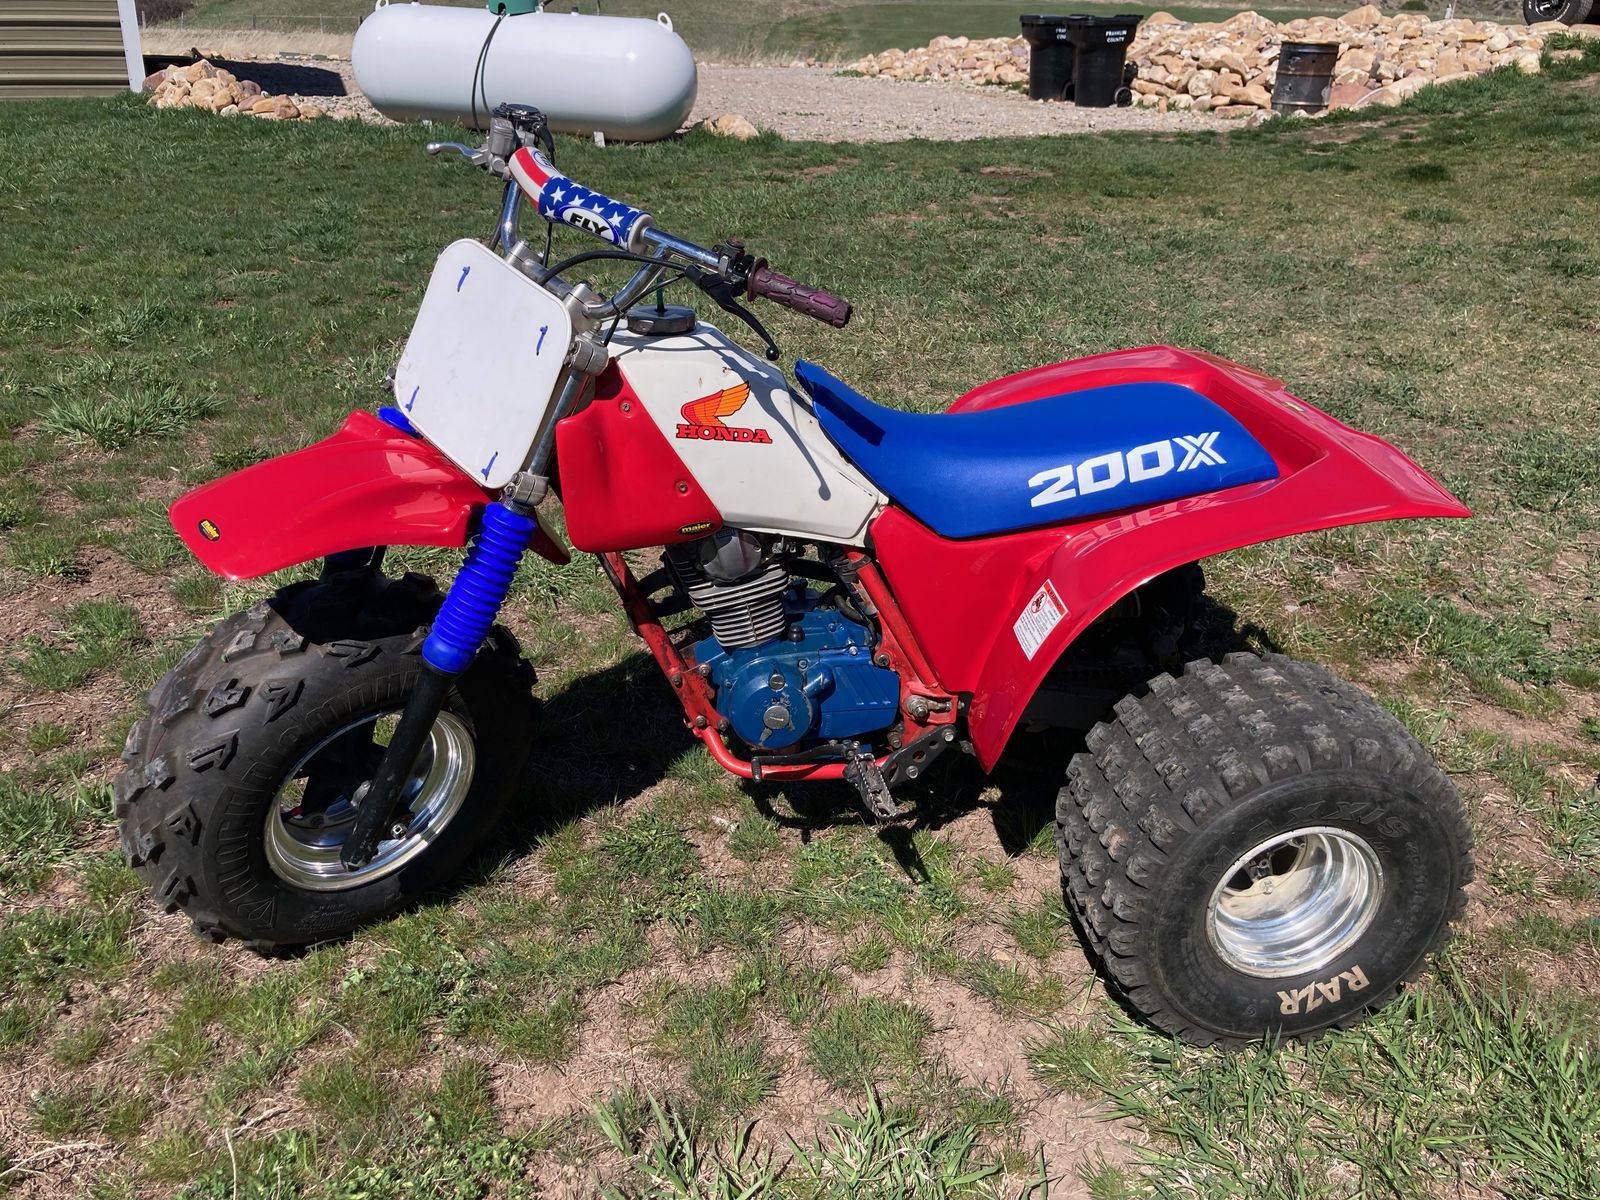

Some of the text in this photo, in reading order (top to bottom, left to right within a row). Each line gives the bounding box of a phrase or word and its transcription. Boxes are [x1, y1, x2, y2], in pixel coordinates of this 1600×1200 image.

[569, 212, 610, 236] FLY
[675, 423, 774, 444] HONDA
[1028, 431, 1228, 508] 200X
[681, 522, 711, 534] maier
[1276, 964, 1371, 1016] RAZR
